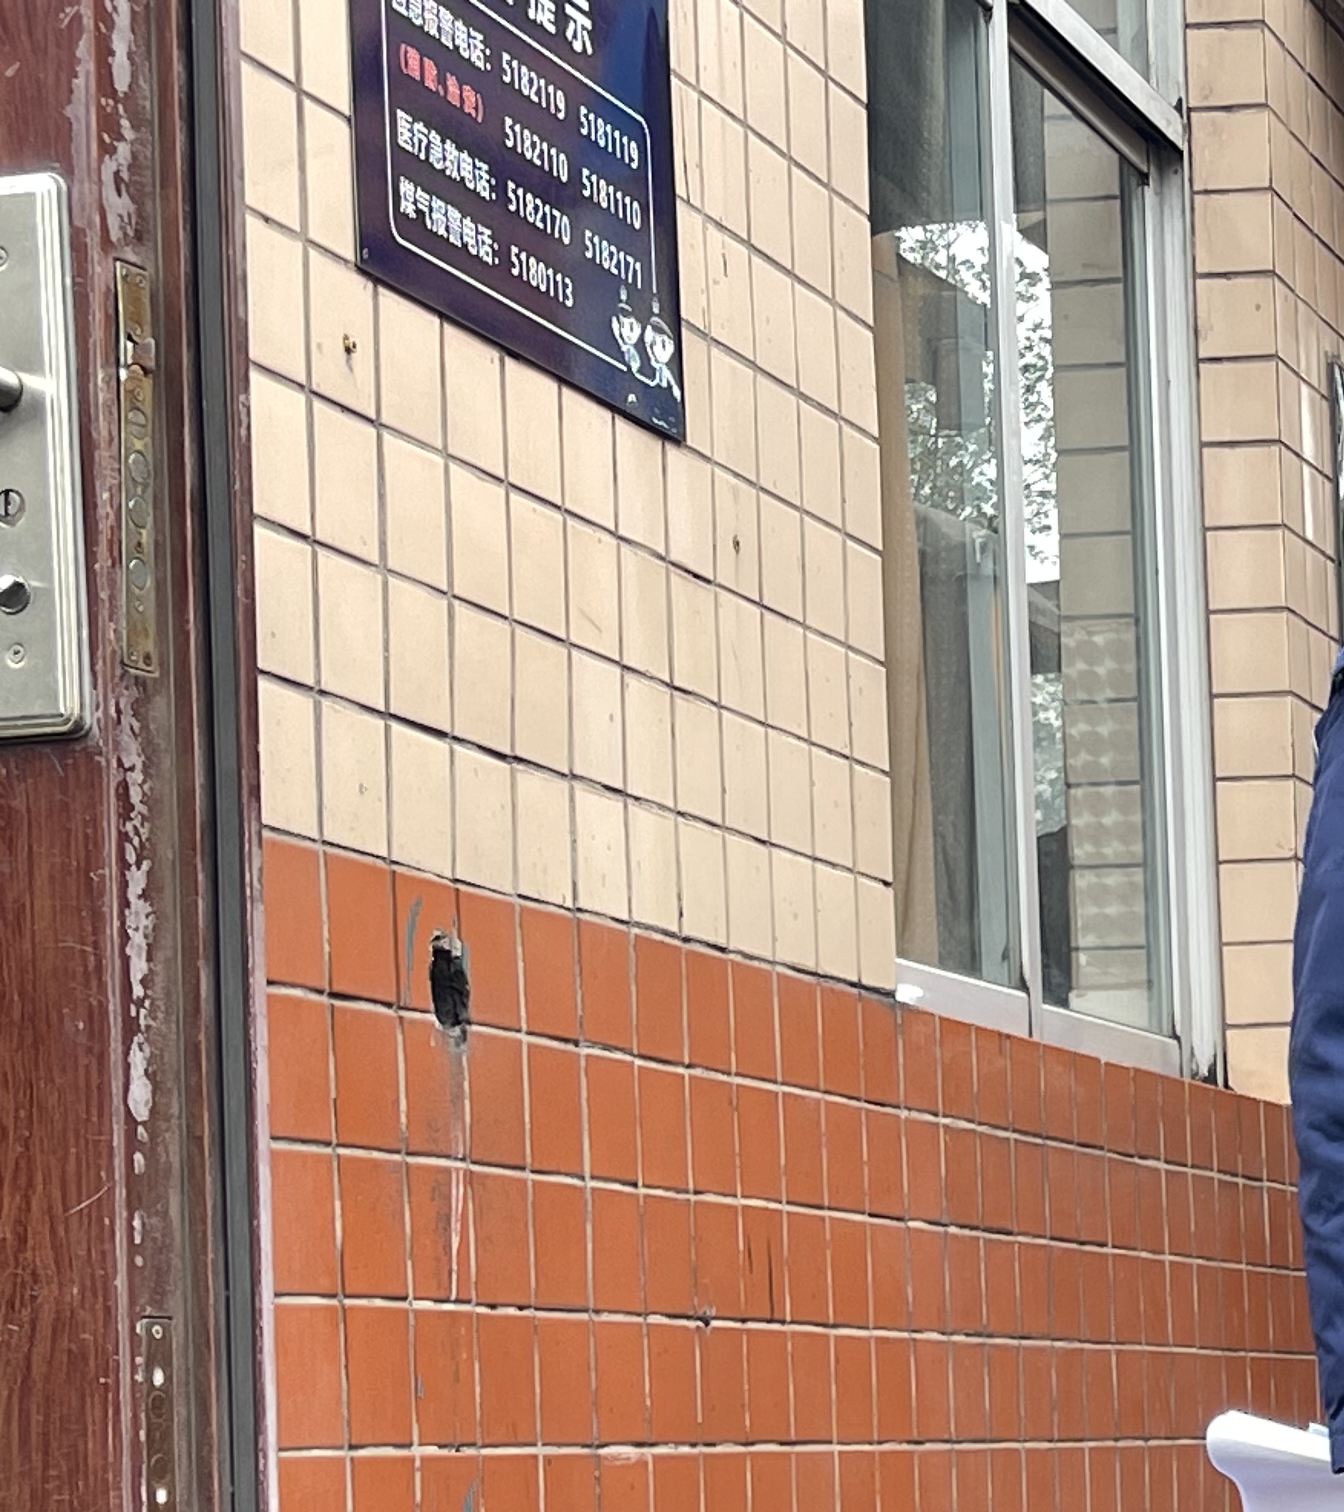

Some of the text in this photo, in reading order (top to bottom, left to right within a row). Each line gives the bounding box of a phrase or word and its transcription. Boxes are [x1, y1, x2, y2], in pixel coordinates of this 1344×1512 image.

[504, 0, 593, 55] 提示
[502, 51, 566, 120] 5182119
[579, 105, 639, 169] 5181119
[504, 116, 569, 183] 5182110
[581, 167, 641, 230] 5181110
[507, 180, 571, 246] 5182170
[584, 229, 642, 289] 5182171
[510, 246, 574, 308] 5180113
